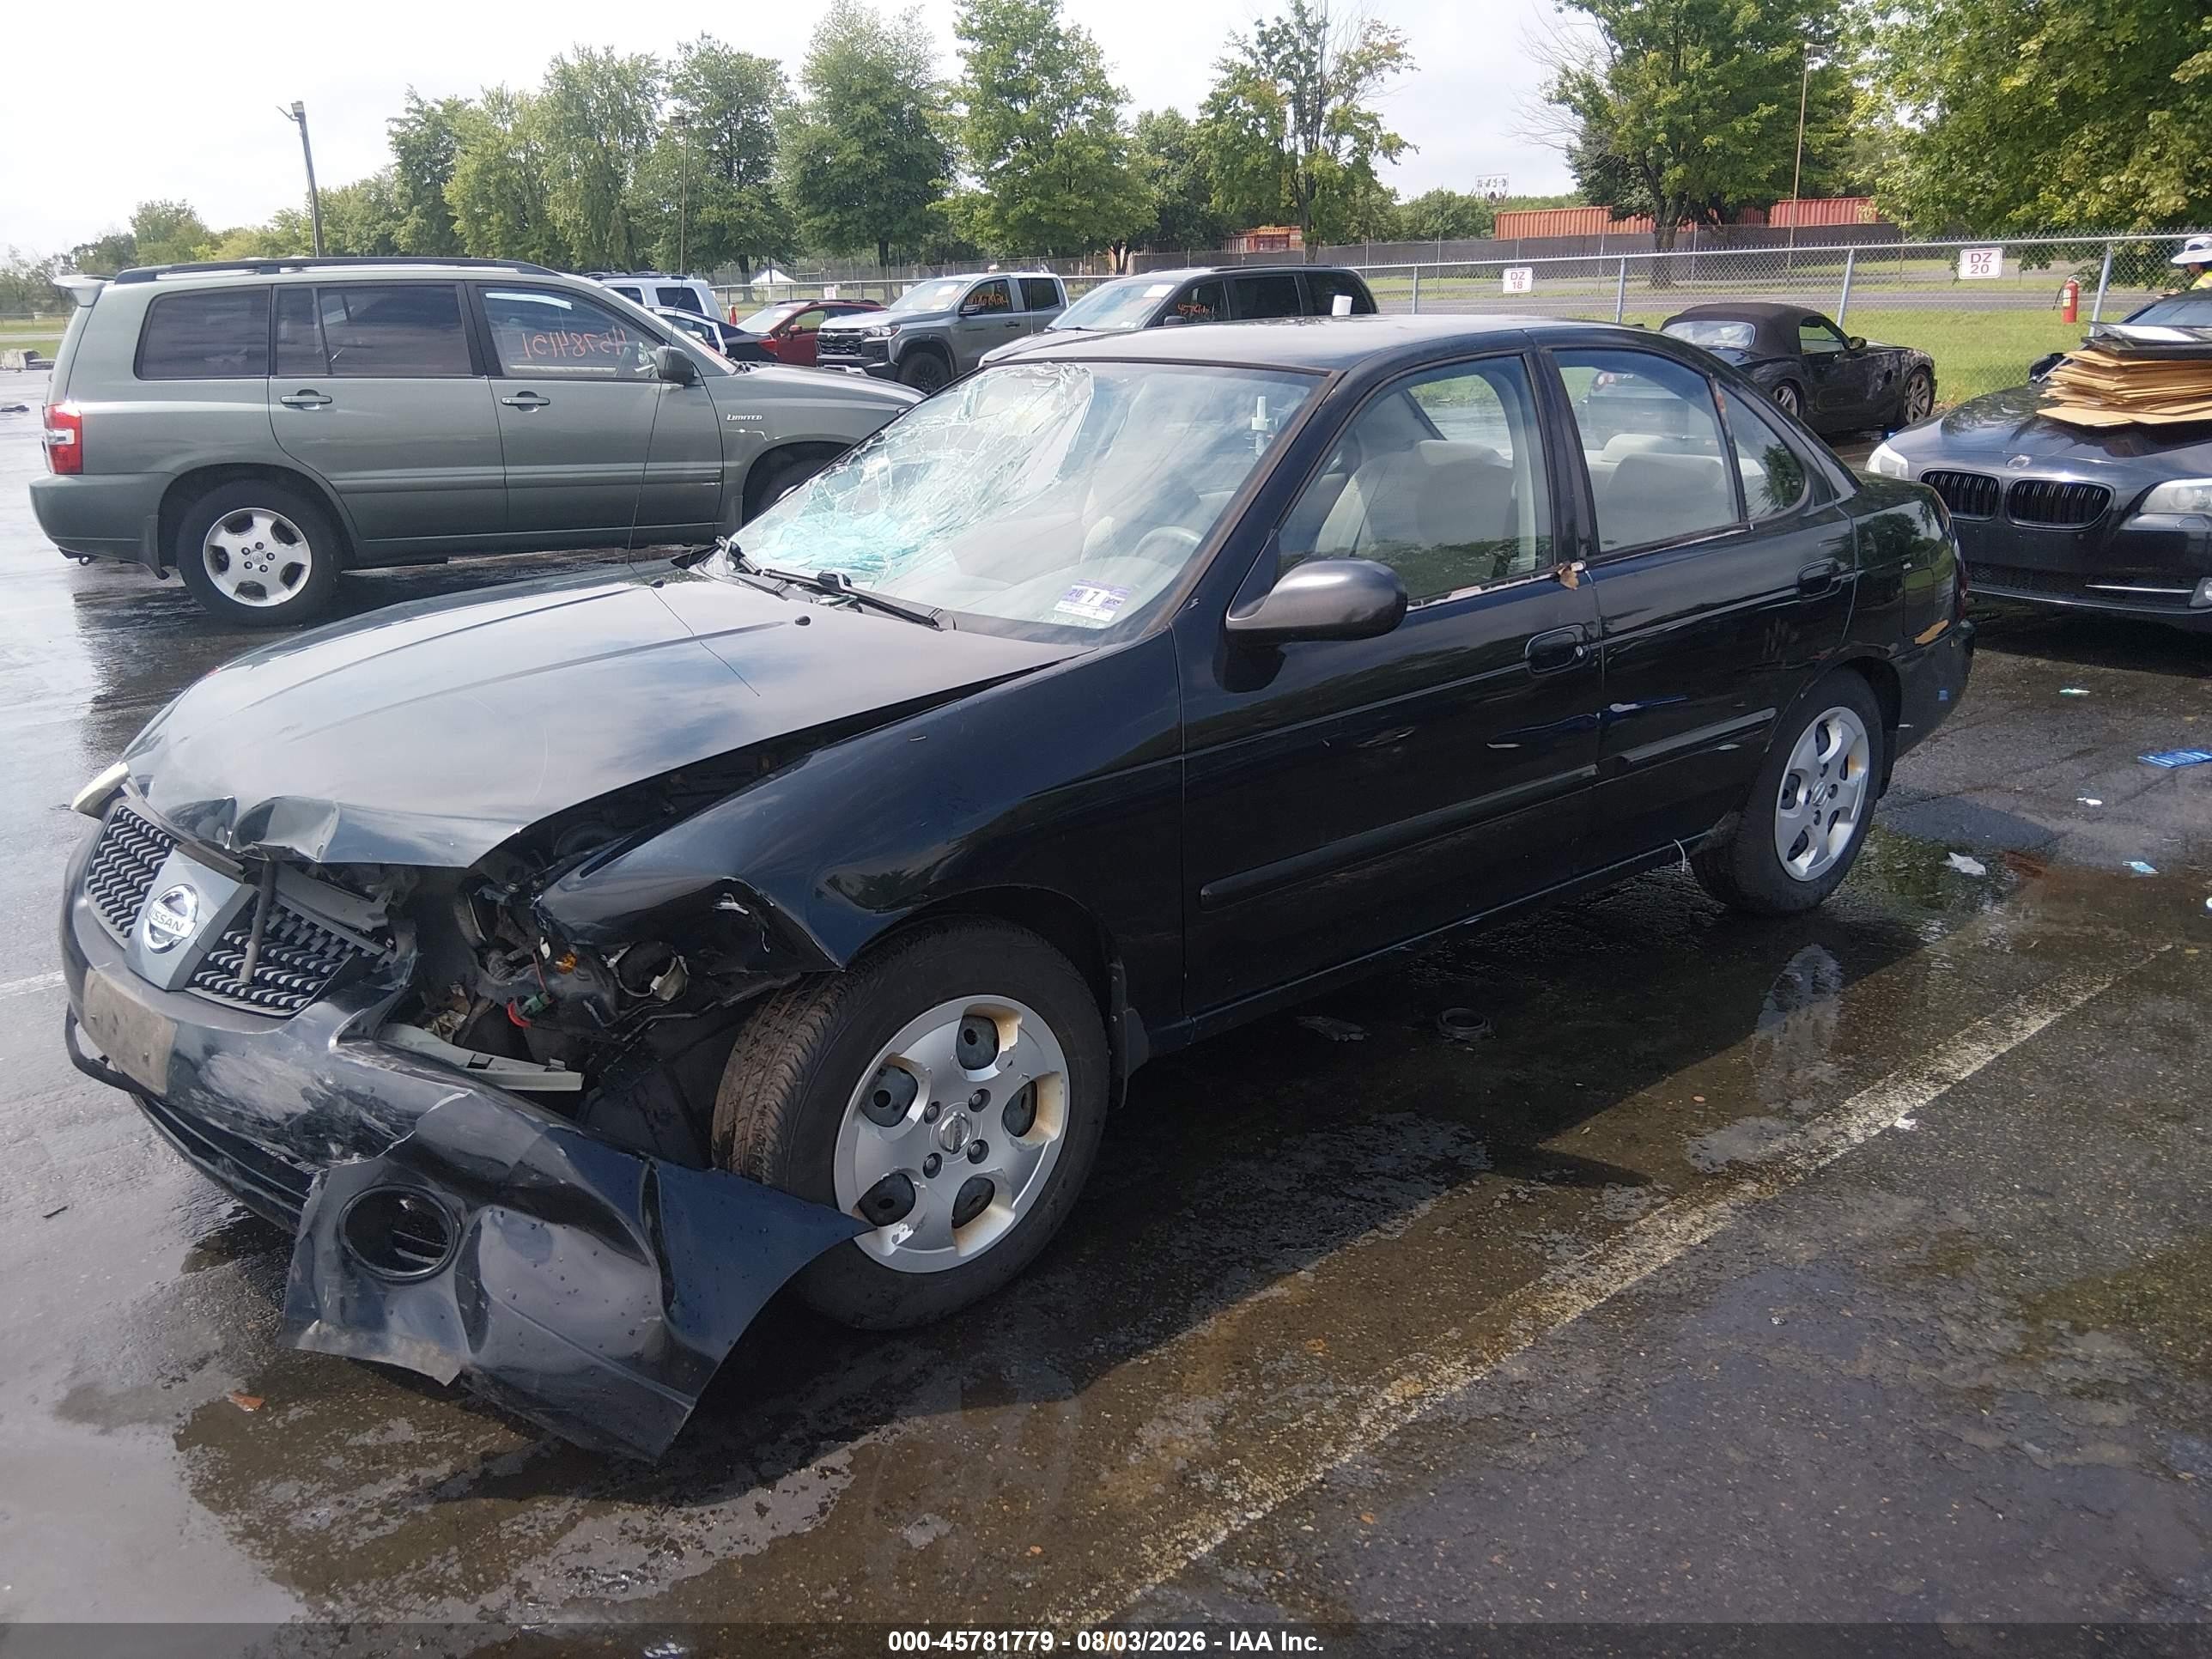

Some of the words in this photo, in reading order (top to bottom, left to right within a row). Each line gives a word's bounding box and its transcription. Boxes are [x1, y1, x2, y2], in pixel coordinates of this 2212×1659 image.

[1971, 252, 1993, 264] DZ
[1971, 264, 1989, 274] 20
[1510, 271, 1525, 281] DZ
[1512, 281, 1523, 289] 18
[1087, 591, 1101, 603] 7
[150, 908, 185, 932] ISSAN
